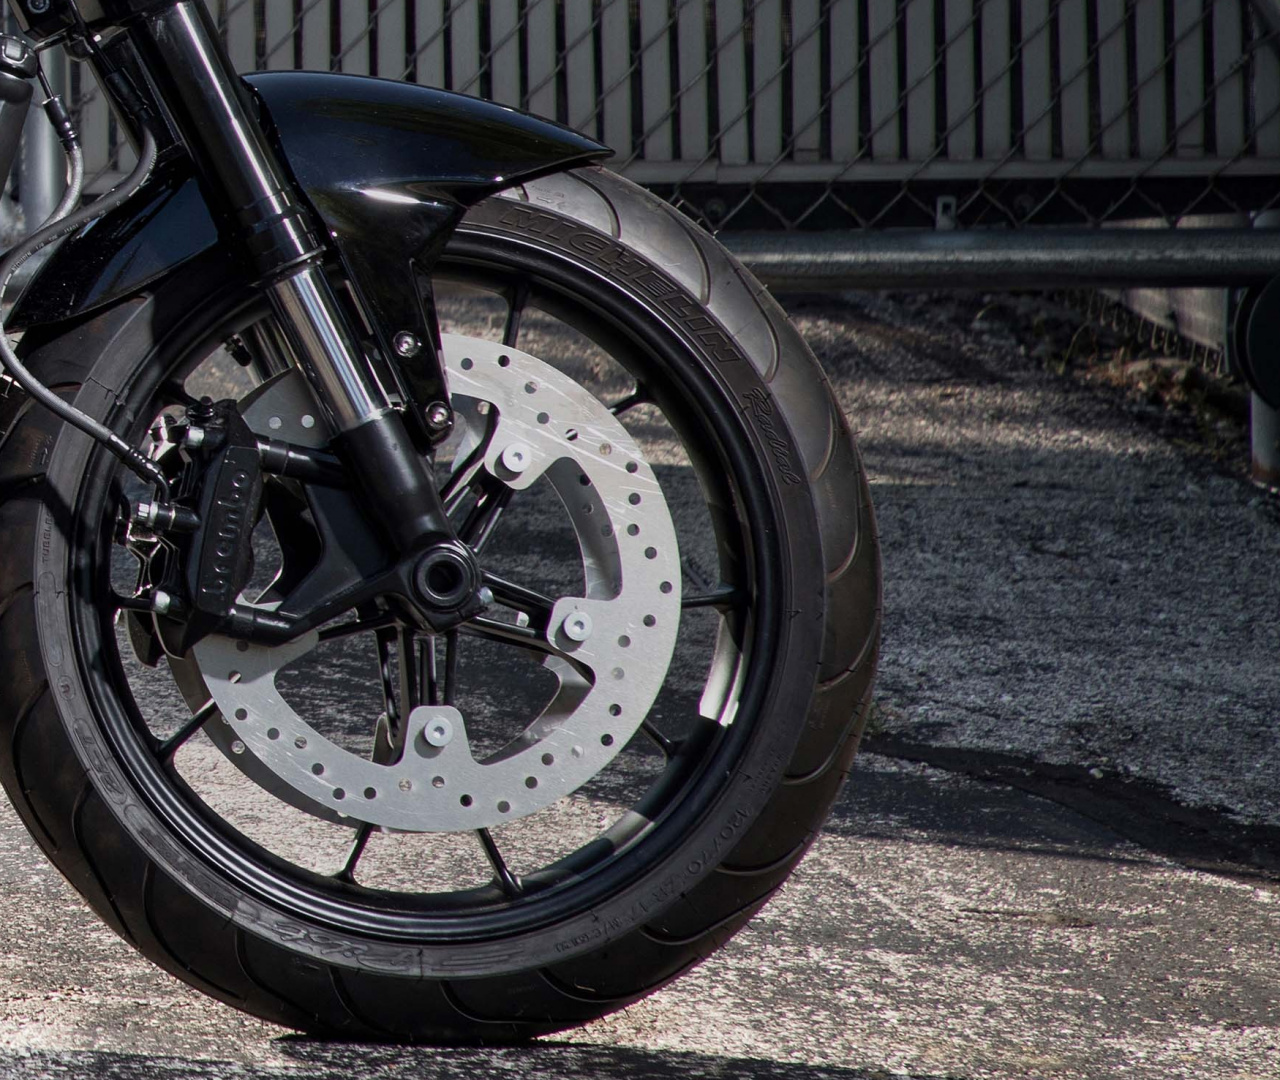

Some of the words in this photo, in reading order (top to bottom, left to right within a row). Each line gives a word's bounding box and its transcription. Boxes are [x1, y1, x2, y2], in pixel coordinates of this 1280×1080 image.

[501, 207, 739, 363] MICHELIN
[744, 387, 800, 486] Radial
[202, 472, 246, 600] brembo
